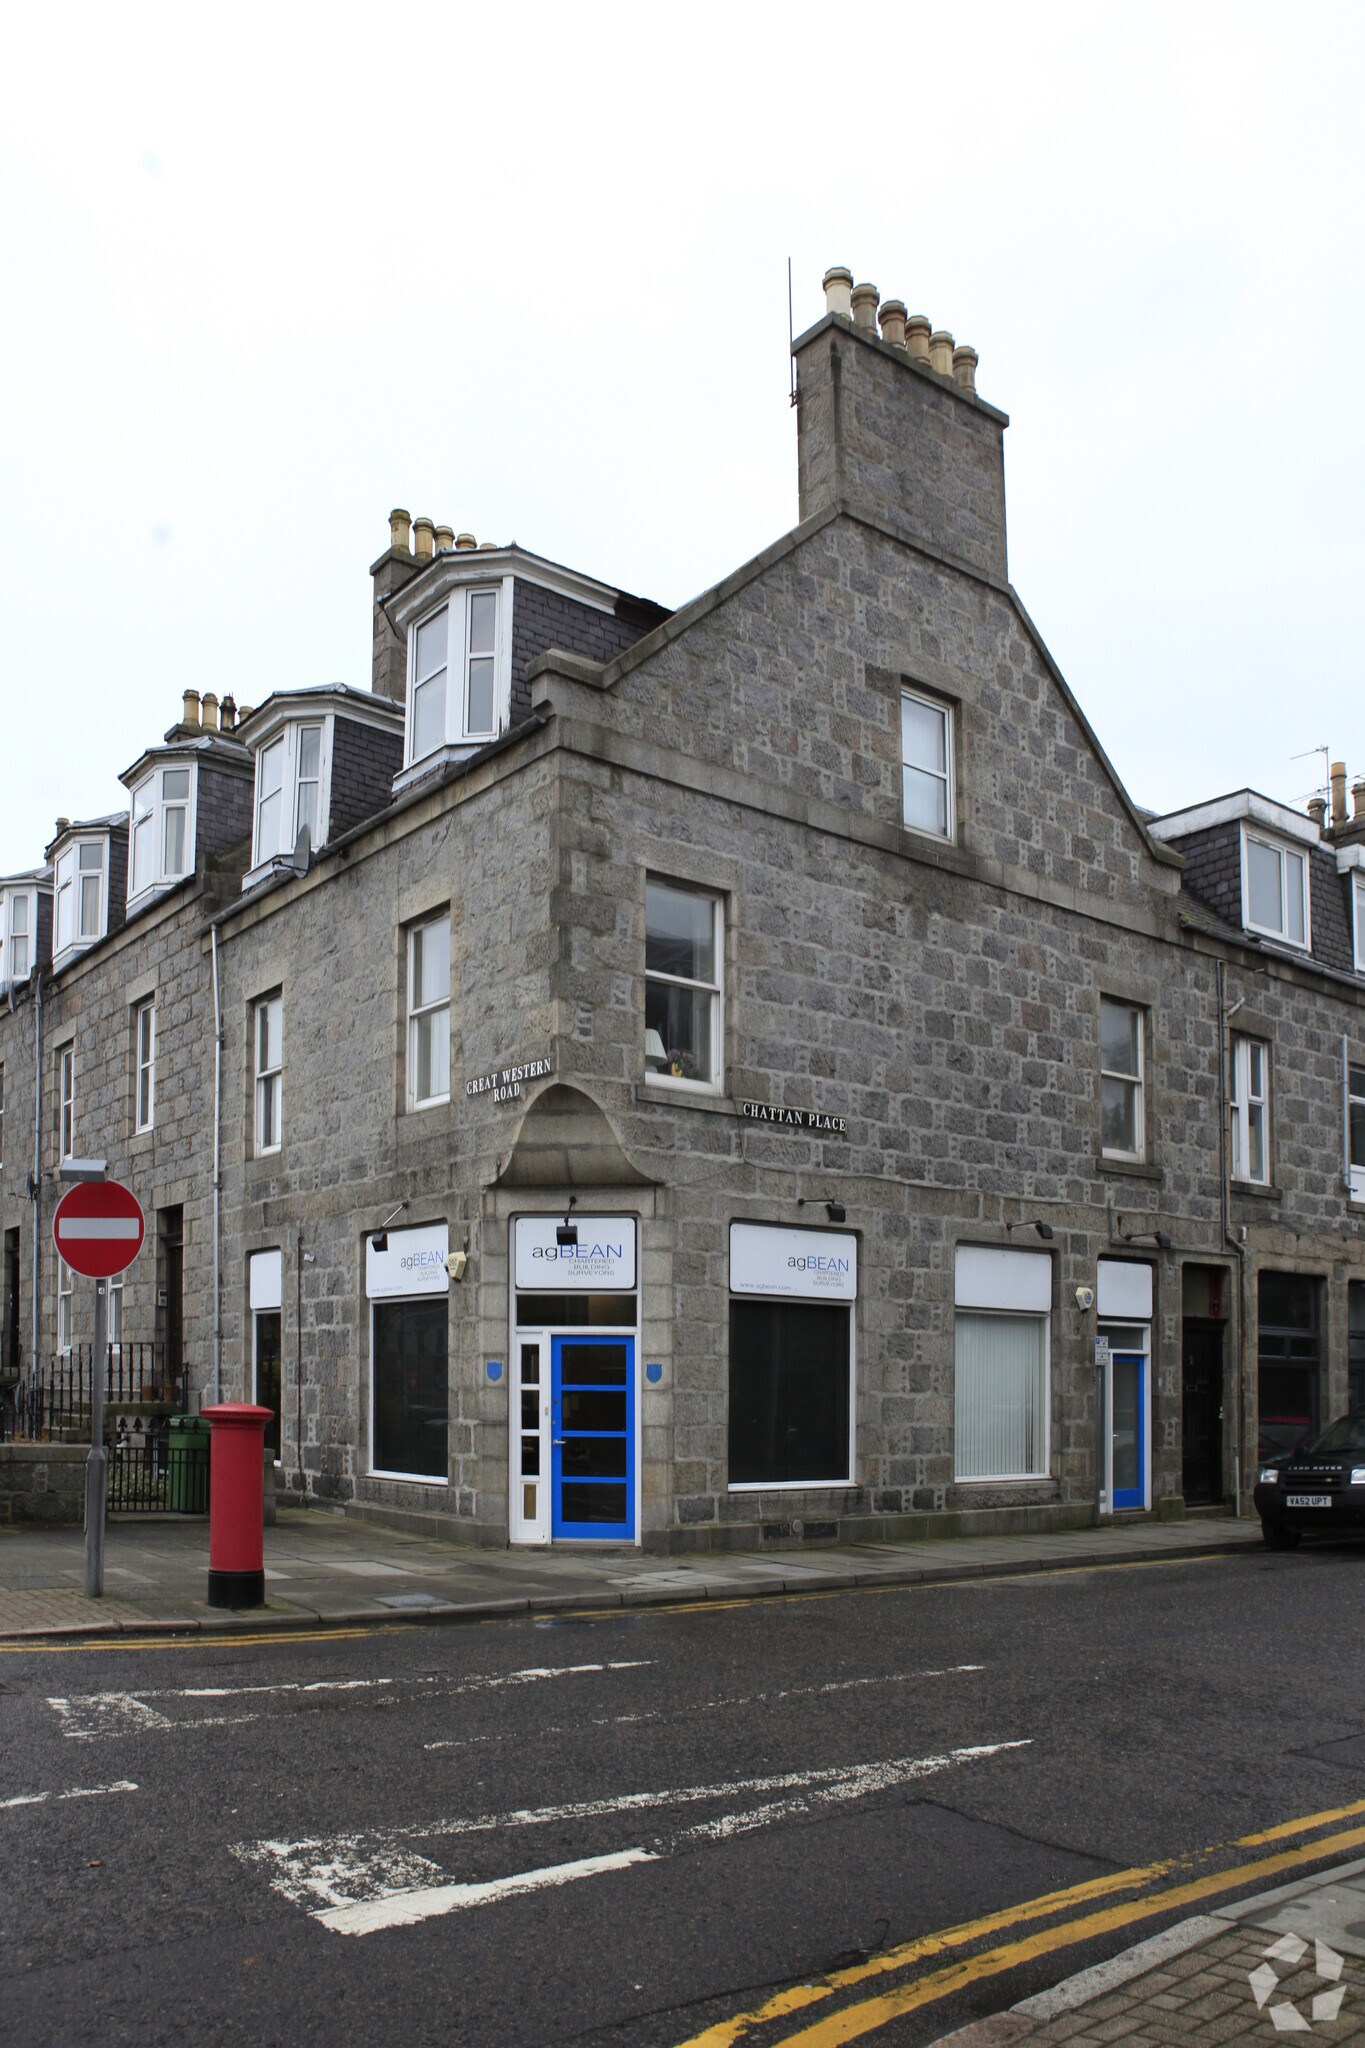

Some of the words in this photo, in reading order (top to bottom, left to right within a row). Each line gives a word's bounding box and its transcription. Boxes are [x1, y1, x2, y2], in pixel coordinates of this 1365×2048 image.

[467, 1073, 498, 1095] GREAT
[502, 1058, 551, 1084] WESTERN
[494, 1082, 520, 1102] ROAD
[743, 1103, 802, 1124] CHATTAN
[808, 1113, 846, 1131] PLACE
[400, 1250, 444, 1270] agBEAN
[532, 1244, 622, 1261] agBEAN
[788, 1256, 849, 1272] agBEAN
[1311, 1497, 1328, 1505] UPT
